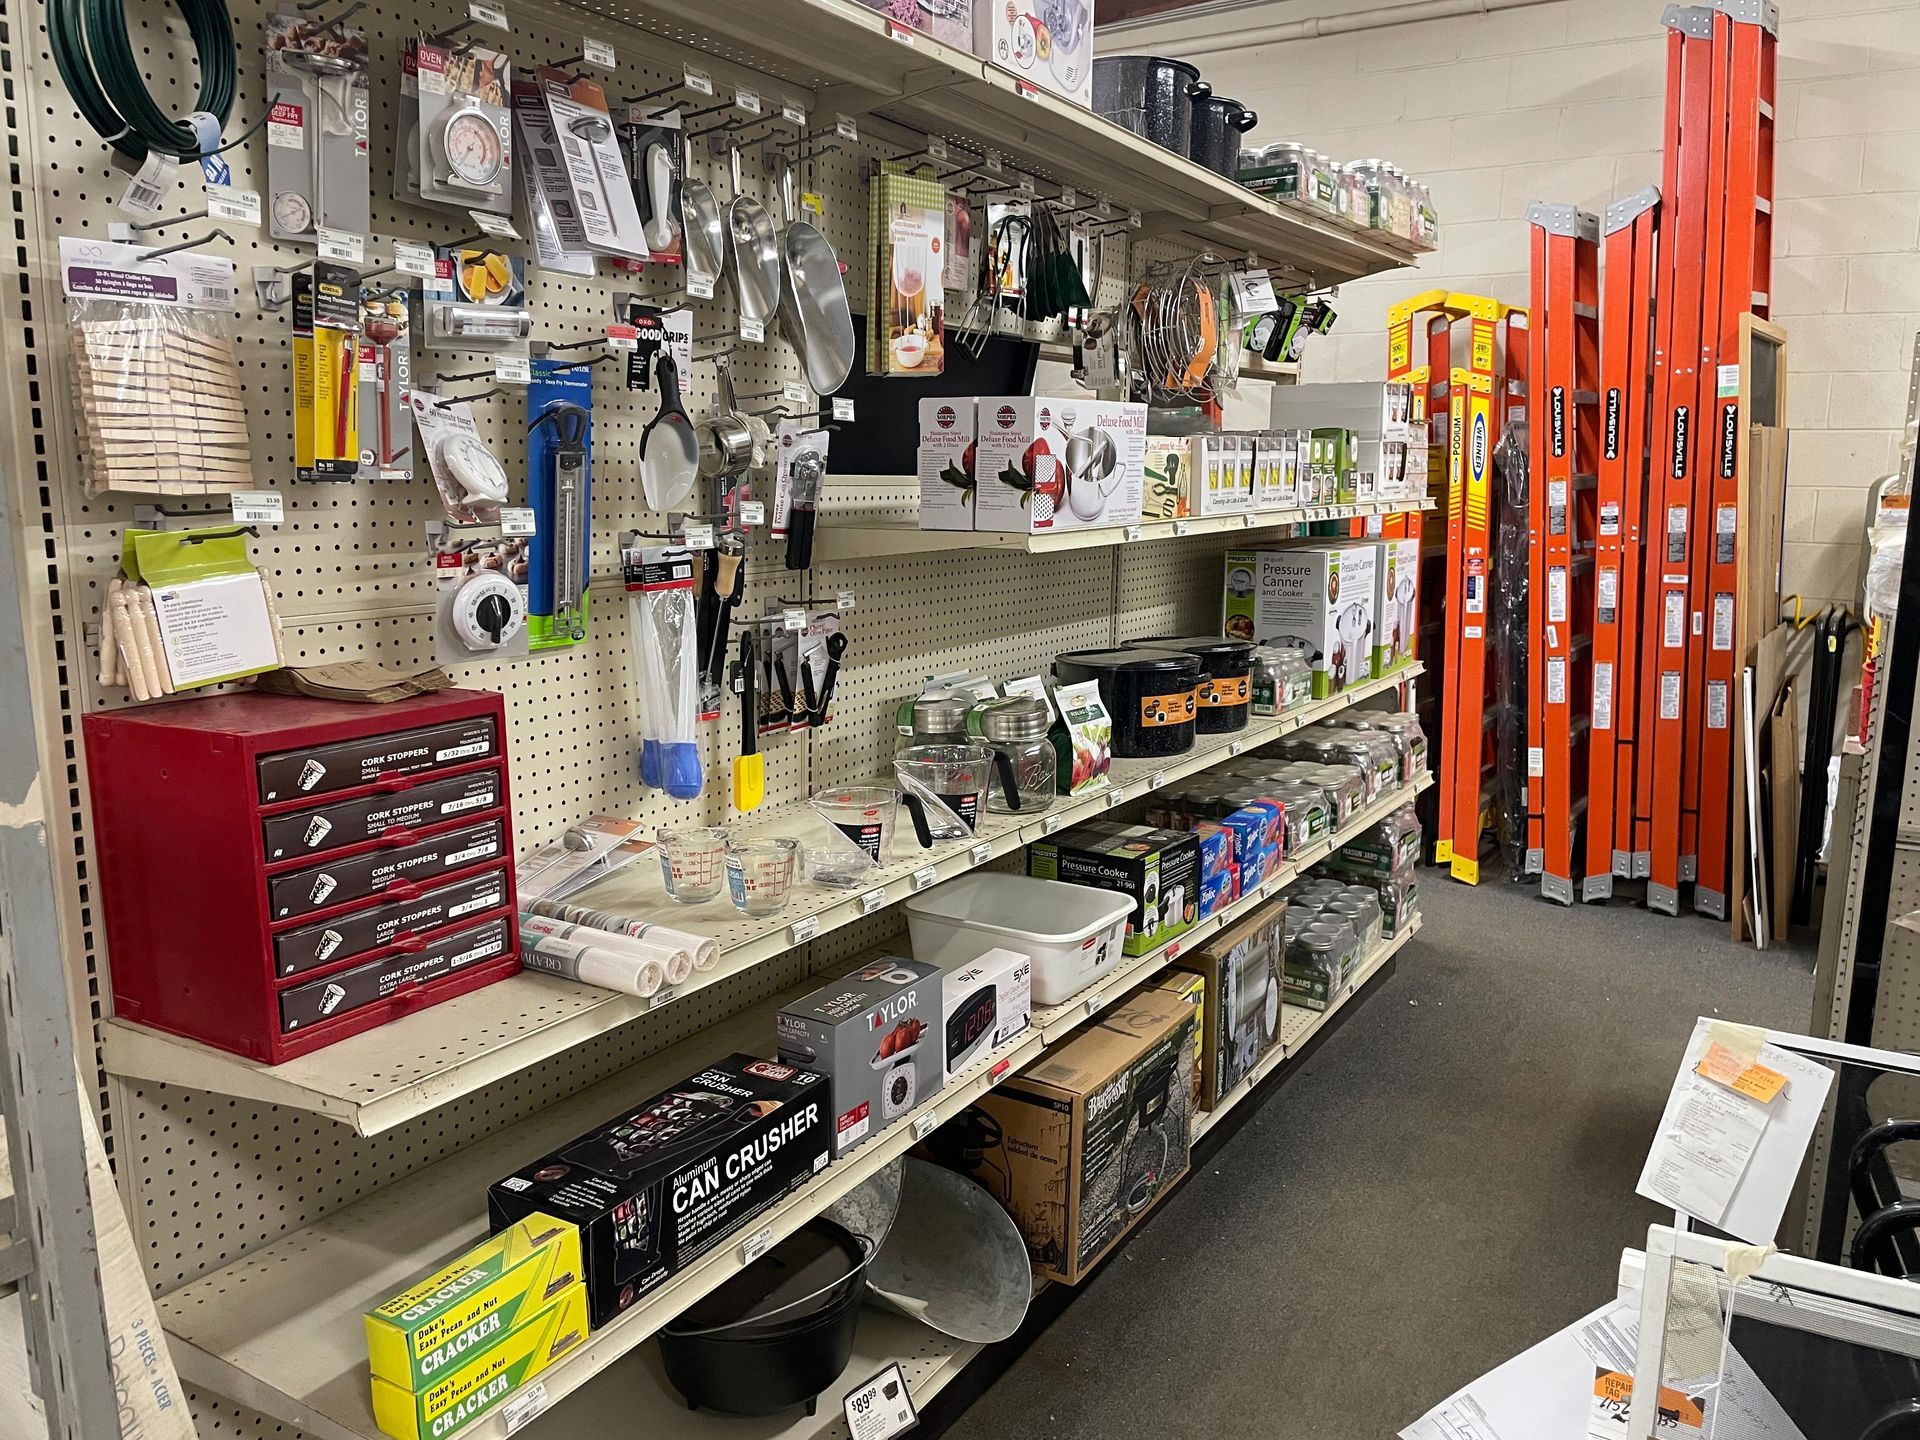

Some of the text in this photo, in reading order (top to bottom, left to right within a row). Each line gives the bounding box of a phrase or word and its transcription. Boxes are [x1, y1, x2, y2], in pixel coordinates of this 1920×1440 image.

[420, 50, 442, 65] OVEN
[287, 112, 298, 120] FRY
[354, 95, 368, 157] TAYLOR
[1264, 178, 1278, 186] JARS
[318, 294, 332, 302] Analog
[636, 328, 660, 340] GOOD
[398, 354, 410, 411] TAYLOR
[531, 369, 552, 378] lassic
[1122, 407, 1137, 415] Stainless
[1606, 388, 1617, 450] LOUISVILLE
[1097, 414, 1145, 428] Deluxe Food Mill
[1554, 398, 1562, 456] LOUISVILLE
[980, 435, 1002, 443] Deluxe
[1018, 436, 1030, 444] Mill
[1453, 417, 1462, 456] PODIUM
[1675, 416, 1684, 478] LOUISVILLE
[1724, 414, 1734, 478] LOUISVILLE
[1262, 563, 1312, 577] Pressure
[1342, 560, 1374, 572] Pressure Canner
[1262, 576, 1304, 588] Canner
[1262, 588, 1304, 598] and Cooker
[460, 736, 483, 745] Household
[361, 747, 429, 767] CORK STOPPERS
[444, 744, 483, 758] 5/32 3/8
[361, 766, 380, 774] SMALL
[464, 788, 487, 797] Household
[366, 800, 434, 822] CORK STOPPERS
[448, 796, 487, 810] 7/16 5/8
[366, 812, 420, 830] SMALL MEDIUM
[468, 838, 490, 848] Household
[1246, 830, 1259, 850] Ziploc
[453, 846, 489, 862] 3/4 7/8
[1161, 850, 1196, 871] Pressure Cooker
[1204, 852, 1216, 868] Ziploc
[1343, 848, 1378, 861] MASON JARS
[372, 852, 438, 877] CORK STOPPERS
[1062, 860, 1129, 879] Pressure Cooker
[371, 874, 396, 885] MEDIUM
[1244, 864, 1257, 886] Ziploc
[1116, 880, 1136, 890] 21-961
[1202, 888, 1216, 905] Ziploc
[461, 902, 473, 912] 3/4
[376, 906, 442, 932] CORK STOPPERS
[376, 928, 395, 938] LARGE
[473, 938, 496, 948] Household
[452, 943, 501, 965] 1-5/16 1-5/8
[521, 952, 562, 971] CREATIV
[380, 955, 444, 984] CORK STOPPERS
[958, 968, 984, 982] SXE
[1013, 962, 1030, 982] SXE
[380, 974, 417, 992] EXTRA LARGE
[1296, 977, 1312, 988] JARS
[814, 992, 857, 1012] TAYLOR
[866, 990, 918, 1032] TAYLOR
[777, 1015, 807, 1030] TAYLOR
[788, 1028, 810, 1038] CAPACITY
[700, 1072, 730, 1083] CAN
[796, 1074, 816, 1084] 10
[691, 1077, 754, 1098] CRUSHER
[1053, 1101, 1070, 1112] SP10
[1008, 1136, 1038, 1150] Estructura
[672, 1164, 720, 1214] CAN
[725, 1102, 820, 1180] CRUSHER
[814, 1156, 828, 1171] USA
[1030, 1150, 1058, 1166] de acero
[672, 1156, 717, 1190] Aluminum
[504, 1180, 526, 1190] USA
[677, 1166, 764, 1224] Never handle messy sharp edged
[677, 1165, 773, 1232] Crushes various sizes cans inch thick
[678, 1195, 740, 1238] Made high-tech, reinforced
[678, 1220, 713, 1246] No paint chip
[387, 1264, 470, 1315] Easy Pecan and Nut
[638, 1270, 668, 1294] Automatically
[380, 1293, 411, 1311] Duke's
[401, 1268, 488, 1322] CRACKER
[418, 1296, 498, 1354] Easy Pecan and Nut
[418, 1318, 446, 1340] Duke's
[420, 1312, 502, 1376] CRACKER
[131, 1318, 172, 1412] 3 PIÈCES ACIER
[428, 1379, 456, 1403] Duke's
[430, 1356, 506, 1415] Easy Pecan and Nut
[1604, 1386, 1620, 1398] TAG
[432, 1372, 510, 1438] CRACKER
